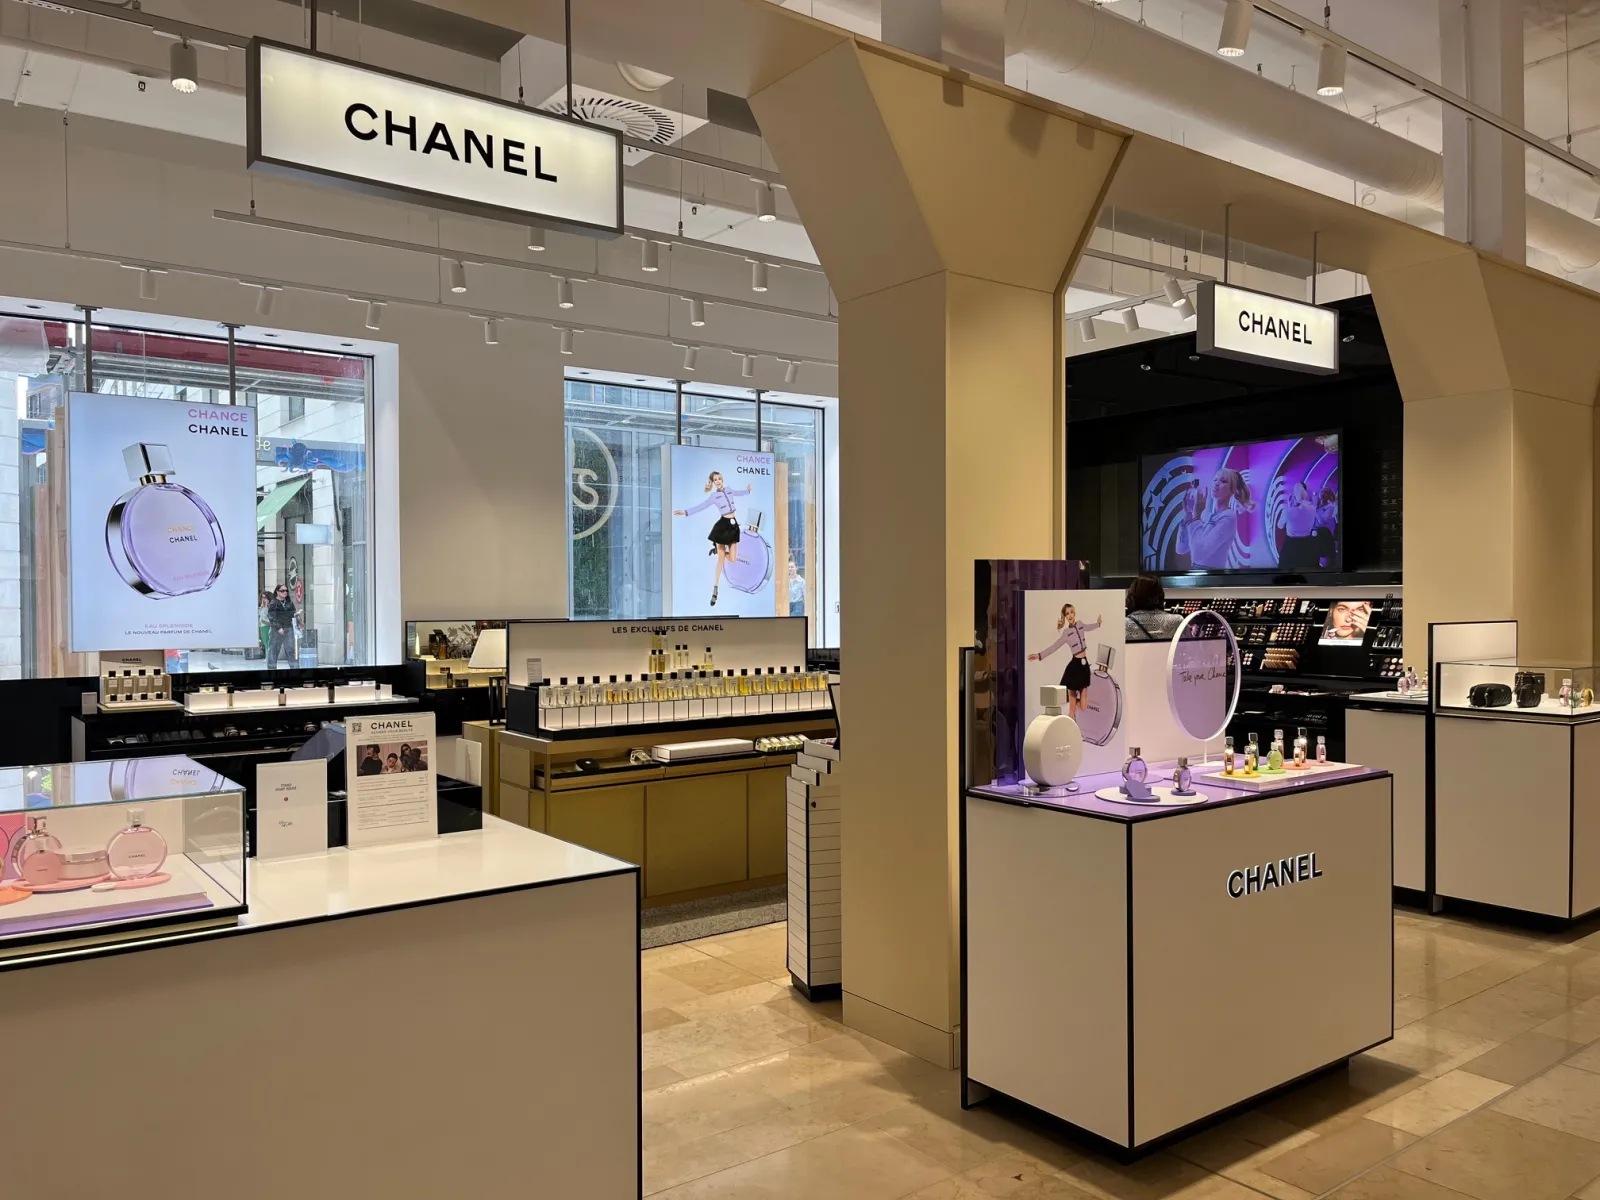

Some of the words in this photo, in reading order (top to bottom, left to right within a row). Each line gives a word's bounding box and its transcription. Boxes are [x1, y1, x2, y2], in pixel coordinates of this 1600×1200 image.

[344, 102, 557, 183] CHANEL
[1238, 310, 1312, 345] CHANEL
[187, 408, 248, 422] CHANCE
[188, 424, 249, 437] CHANEL
[736, 454, 771, 465] CHANCE
[736, 466, 771, 476] CHANEL
[169, 535, 198, 544] CHANEL
[612, 626, 628, 634] LES
[370, 720, 413, 730] CHANEL
[1226, 852, 1323, 899] CHANEL
